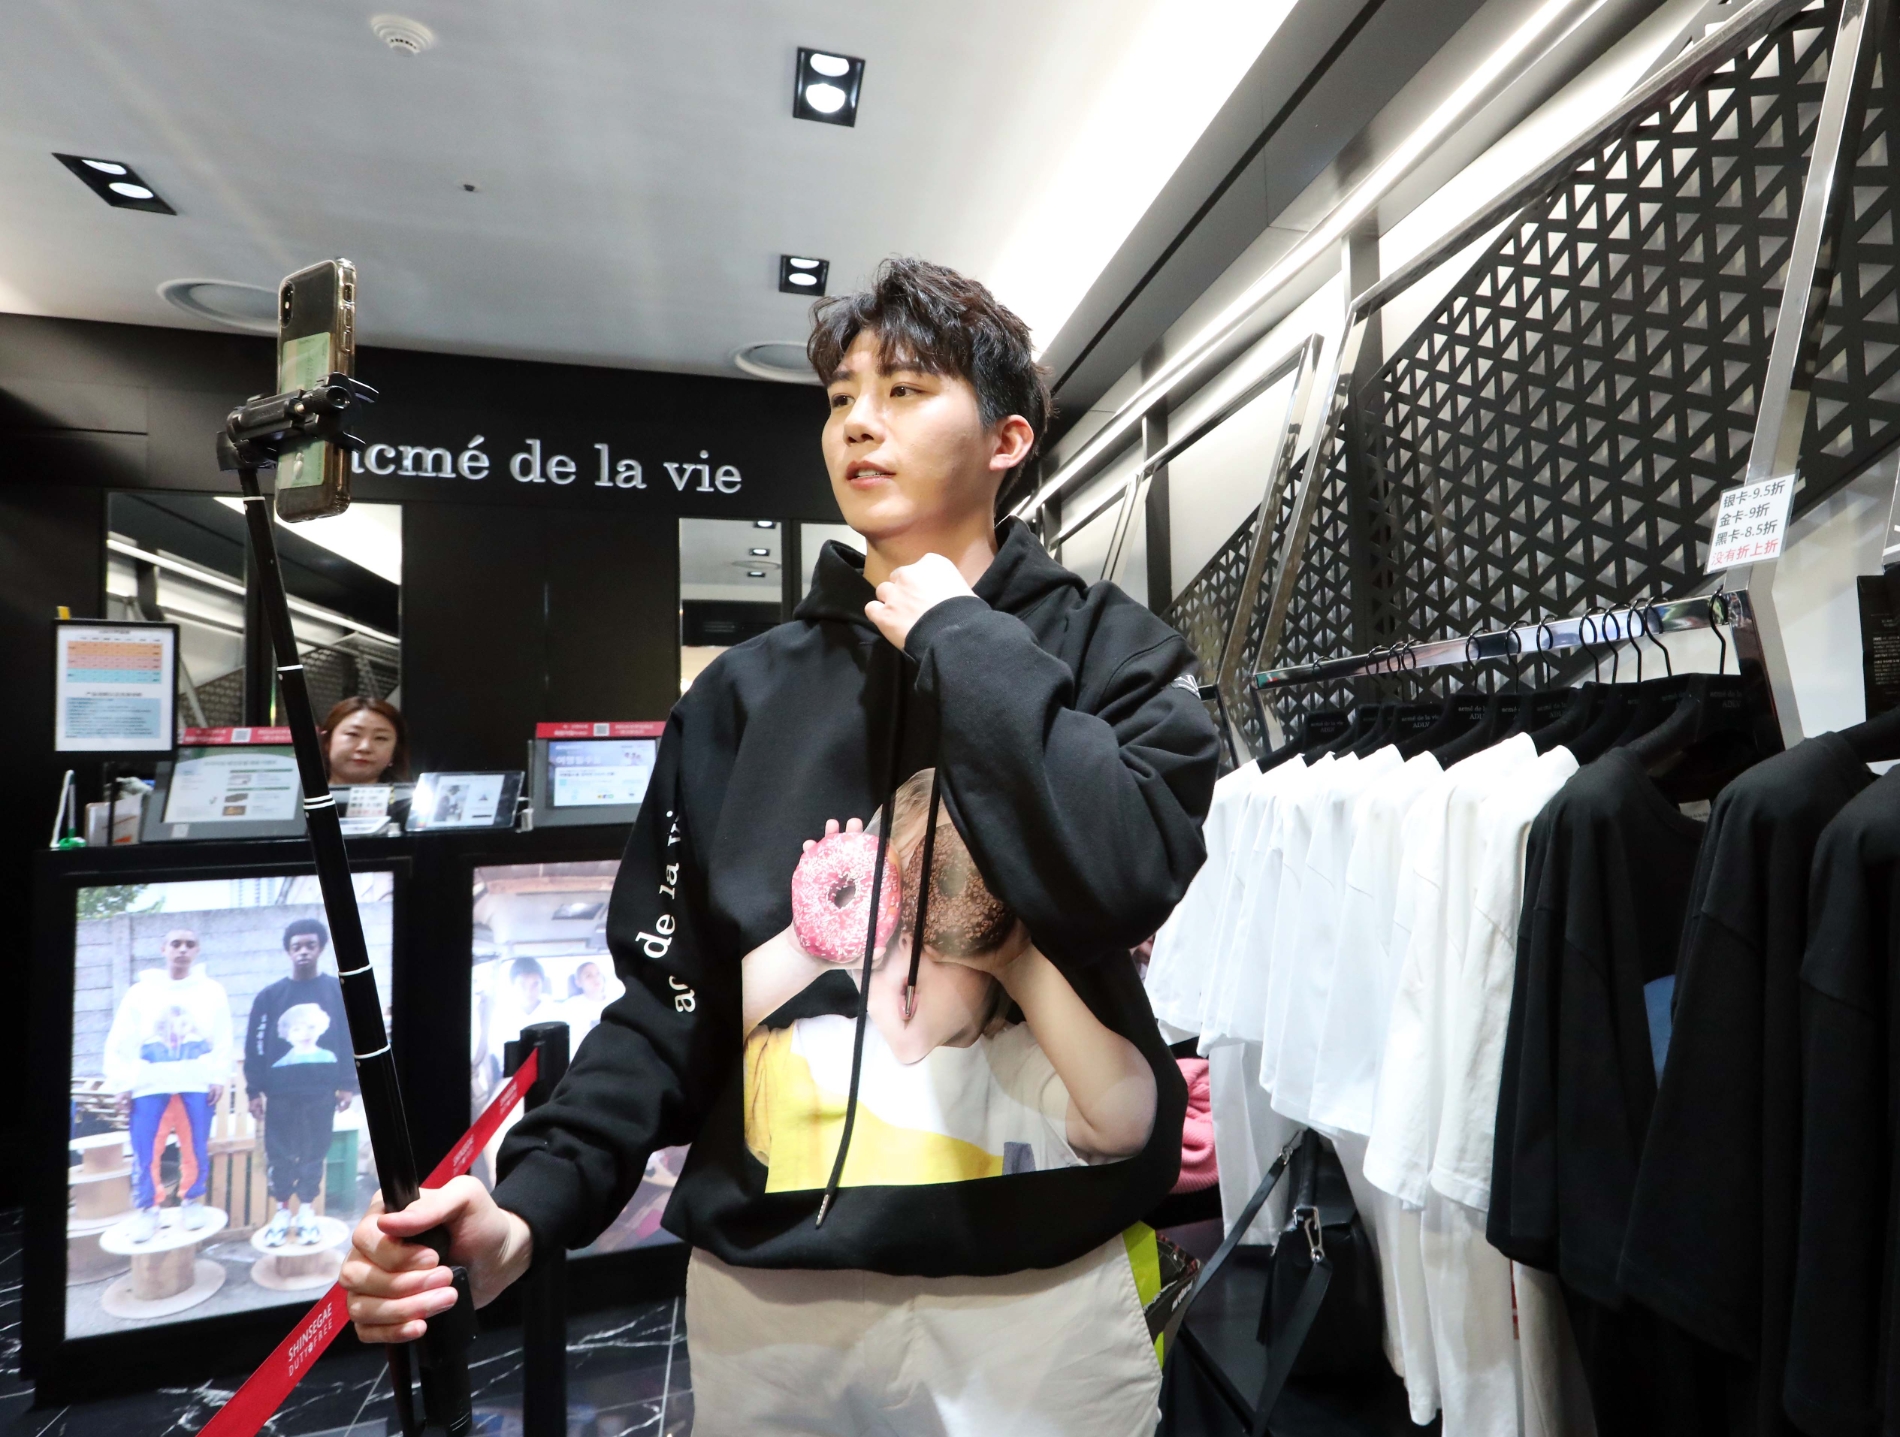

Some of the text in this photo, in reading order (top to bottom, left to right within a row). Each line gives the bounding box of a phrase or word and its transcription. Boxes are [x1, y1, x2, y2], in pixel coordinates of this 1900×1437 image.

[510, 439, 577, 485] de
[594, 443, 647, 489] la
[663, 450, 742, 494] vie
[1723, 480, 1786, 508] 银卡-9.5折
[1719, 502, 1771, 528] 金卡-9折
[1715, 519, 1778, 546] 黑卡-8.5折
[1711, 538, 1779, 566] 没有折上折
[635, 914, 676, 959] de
[659, 862, 680, 900] la
[288, 1302, 332, 1362] SHINSEGAE
[313, 1318, 333, 1348] FREE
